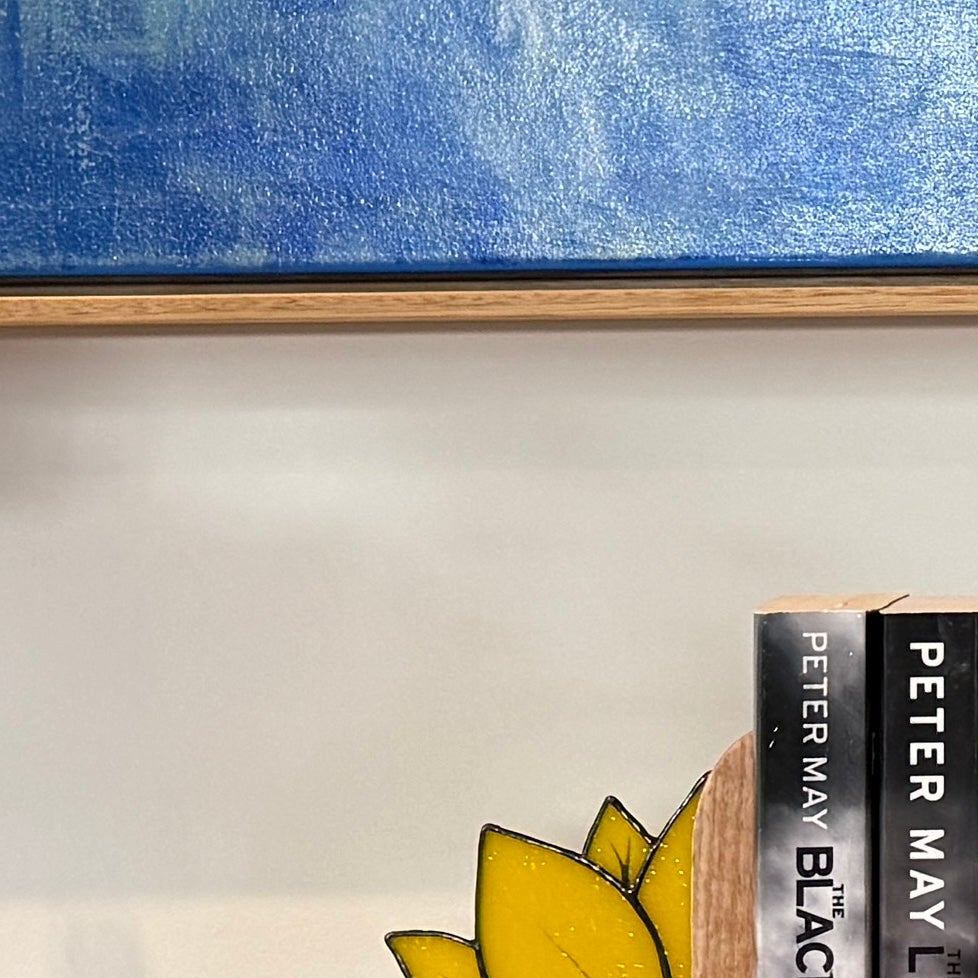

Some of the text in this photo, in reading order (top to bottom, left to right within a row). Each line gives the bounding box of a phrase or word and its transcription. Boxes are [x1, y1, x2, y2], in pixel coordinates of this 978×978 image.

[801, 632, 828, 830] PETER MAY
[908, 641, 945, 931] PETER MAY
[832, 883, 845, 919] THE
